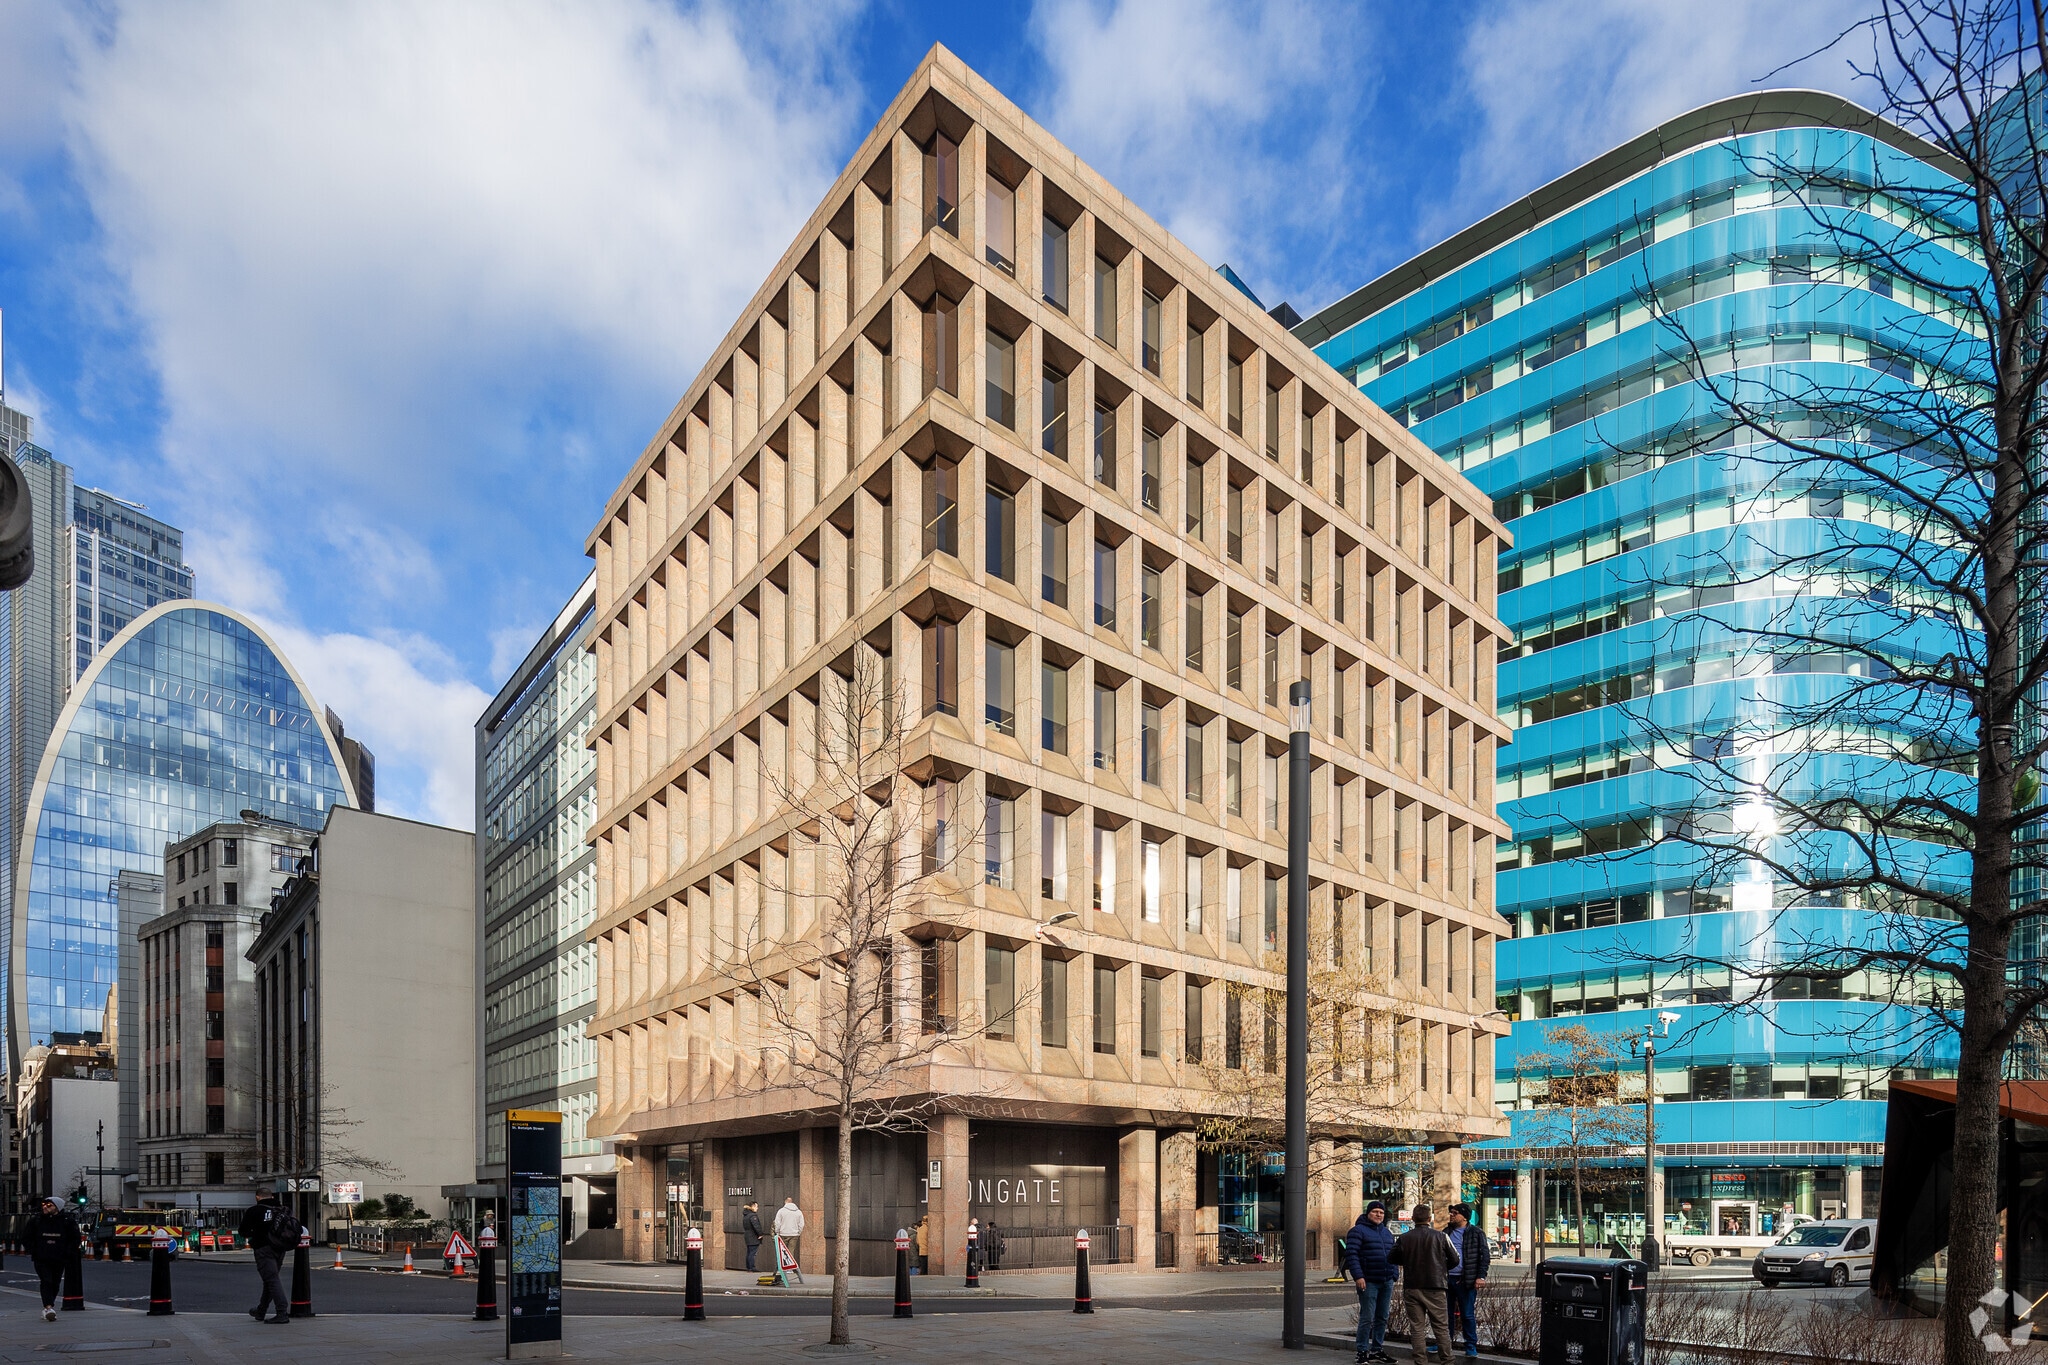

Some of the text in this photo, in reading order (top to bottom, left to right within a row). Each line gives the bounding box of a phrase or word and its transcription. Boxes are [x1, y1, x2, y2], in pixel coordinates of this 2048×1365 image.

[1712, 1173, 1747, 1181] TESCO
[728, 1187, 752, 1196] IRONGATE
[921, 1178, 1061, 1204] INGATE
[1369, 1180, 1404, 1195] PUR
[1712, 1184, 1745, 1193] express
